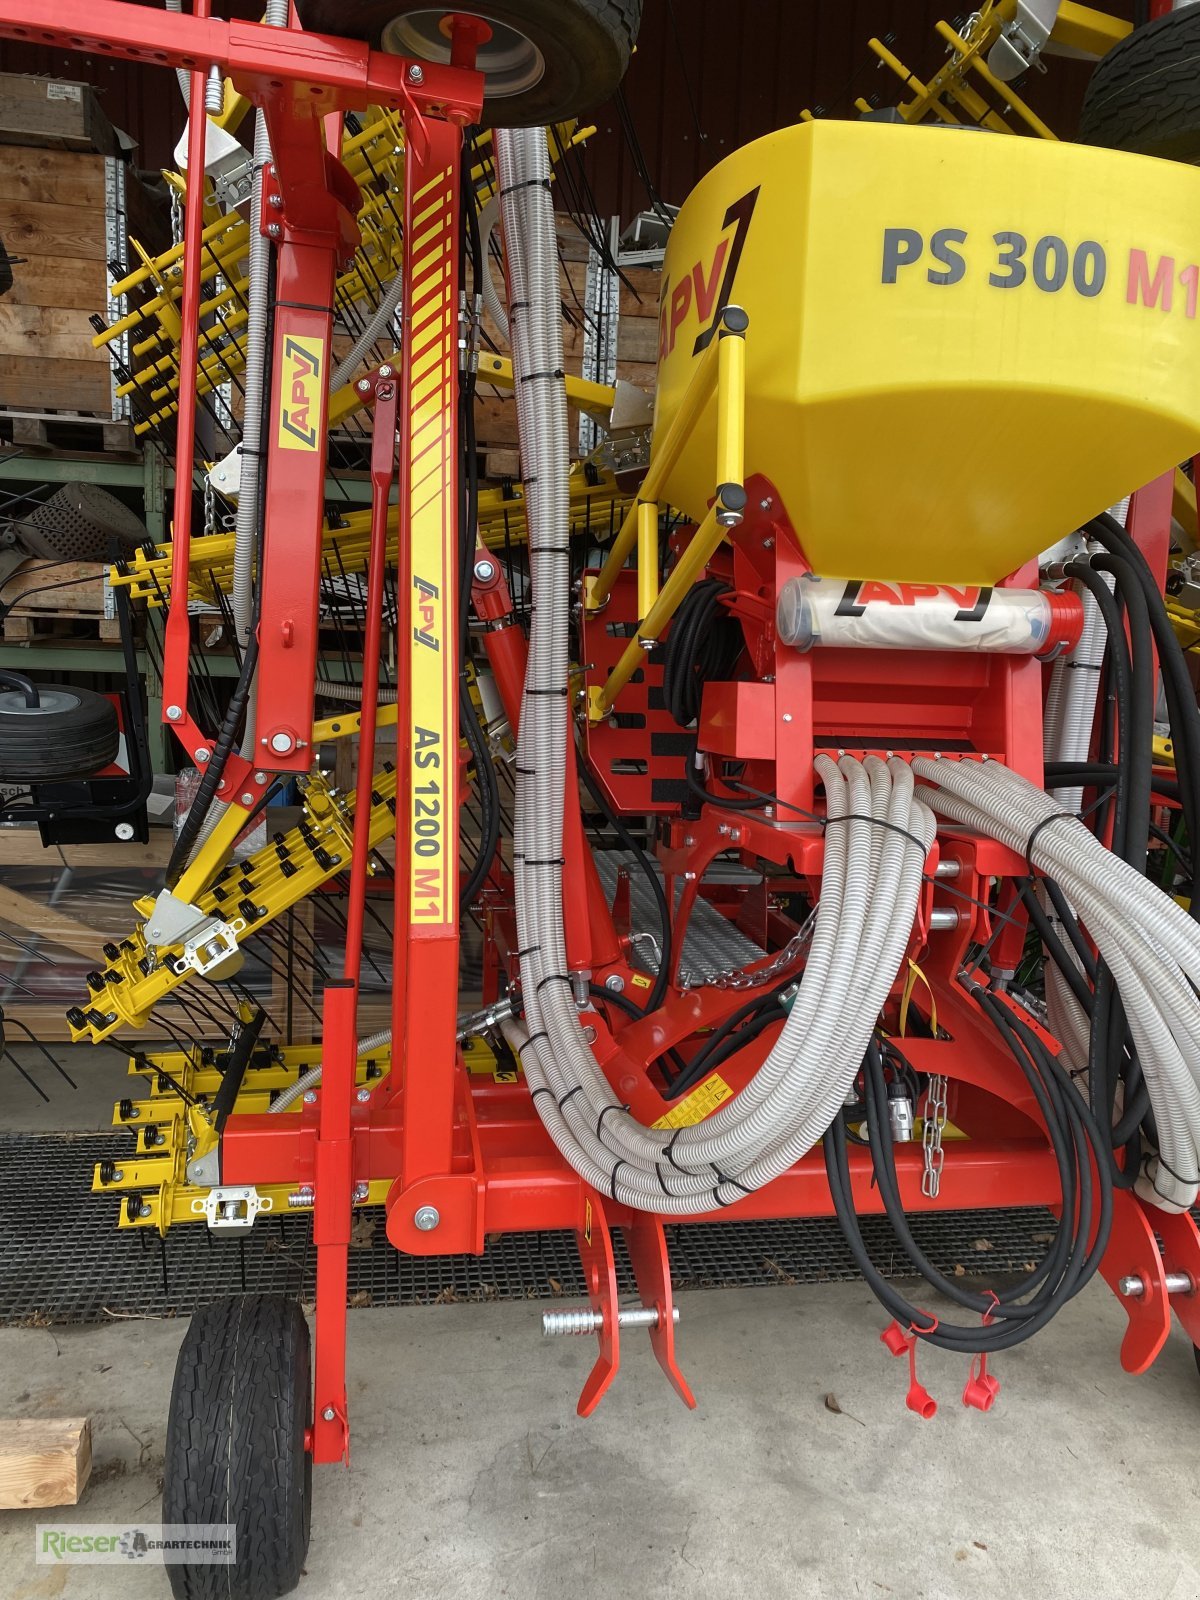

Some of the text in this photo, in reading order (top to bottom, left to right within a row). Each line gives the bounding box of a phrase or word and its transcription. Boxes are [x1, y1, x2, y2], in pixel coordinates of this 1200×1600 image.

[881, 228, 1200, 320] PS 300 M1
[857, 580, 981, 609] APV
[414, 726, 440, 917] AS 1200 M1
